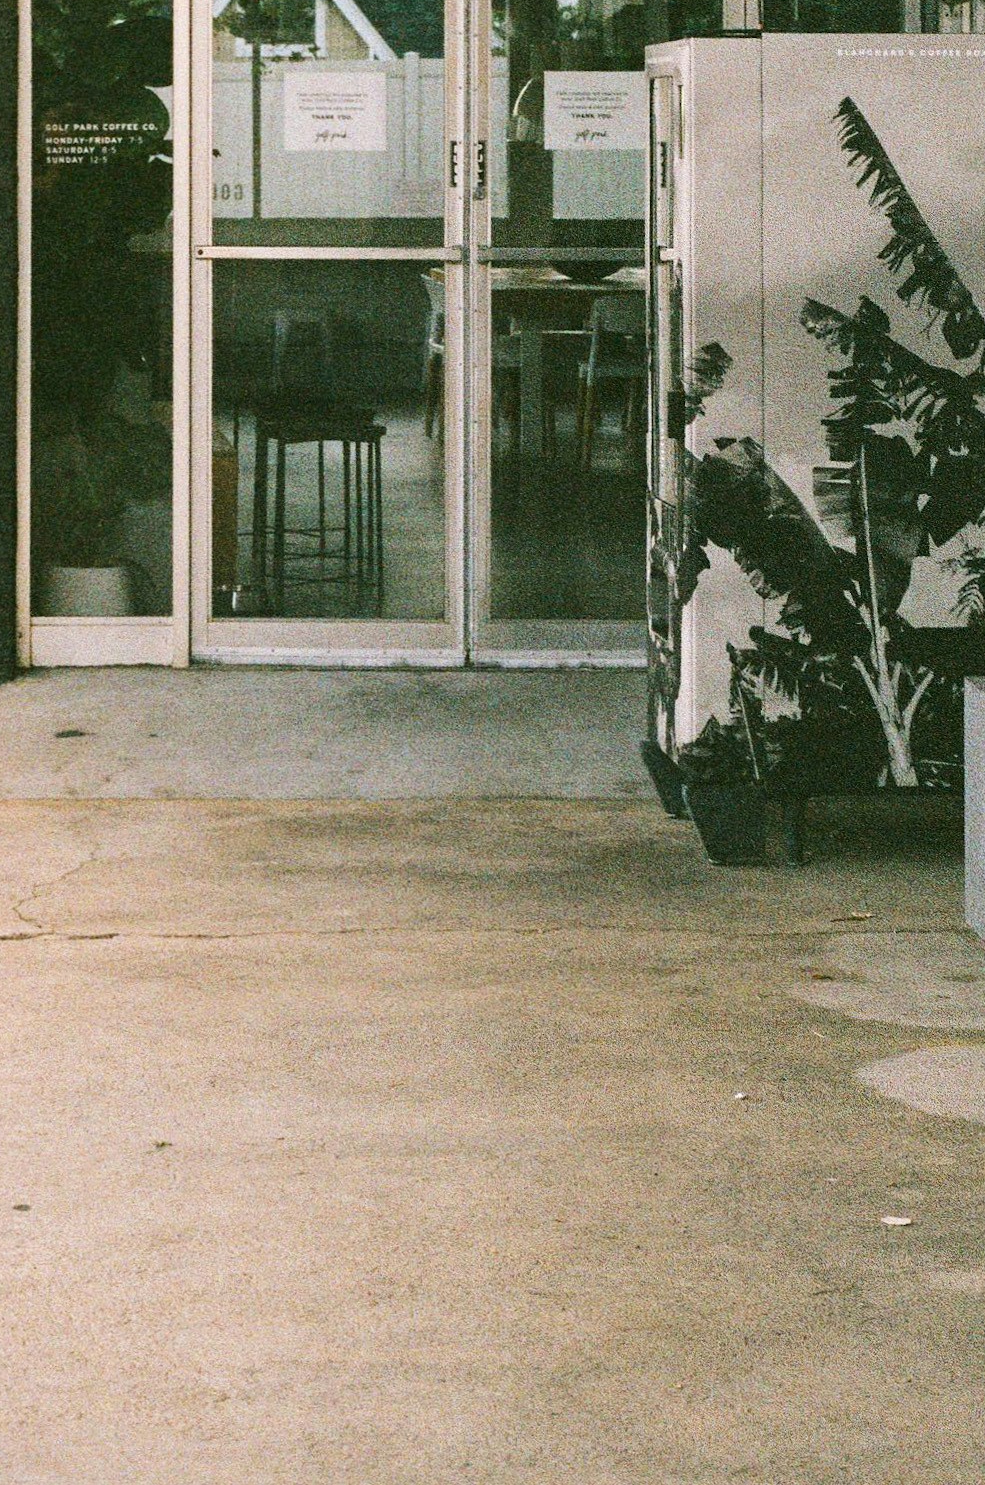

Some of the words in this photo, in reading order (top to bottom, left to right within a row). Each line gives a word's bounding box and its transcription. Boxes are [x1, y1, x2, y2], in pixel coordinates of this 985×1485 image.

[45, 123, 70, 131] GOLF
[72, 123, 100, 131] PARK
[102, 123, 139, 131] COFFEE
[141, 122, 158, 131] CO.
[45, 146, 96, 154] SATURDAY
[46, 156, 84, 164] SUNDAY
